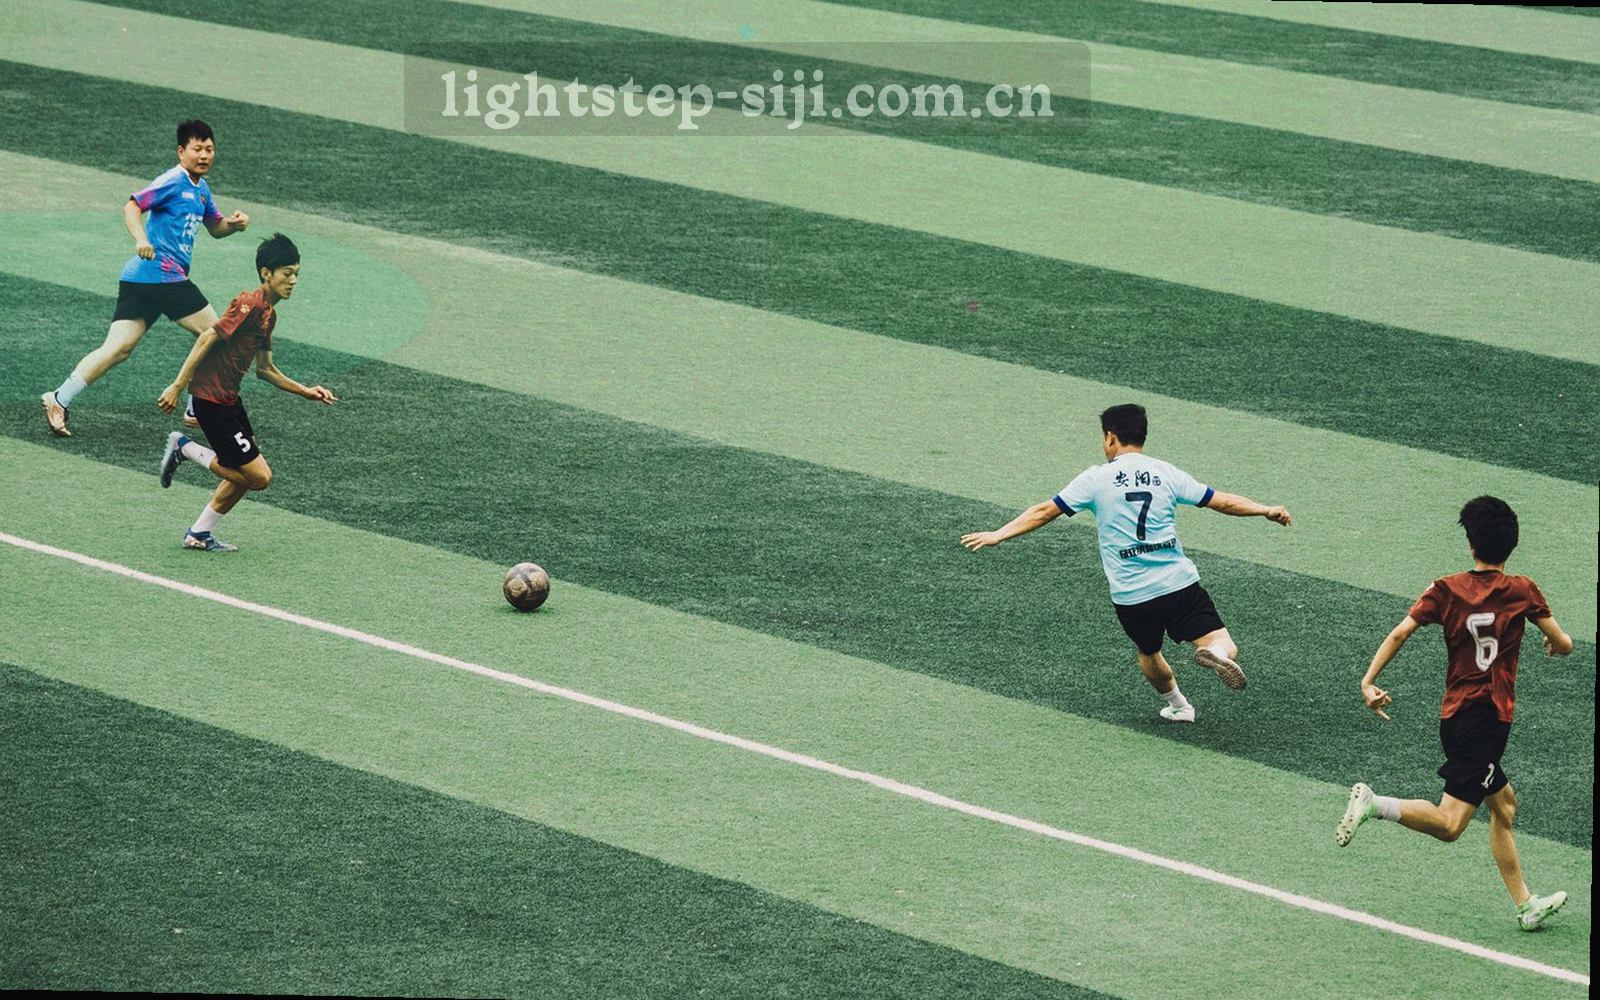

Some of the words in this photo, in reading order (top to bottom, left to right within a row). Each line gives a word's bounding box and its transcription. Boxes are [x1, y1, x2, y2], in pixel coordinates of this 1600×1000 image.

[234, 431, 251, 453] 5
[1125, 492, 1152, 541] 7
[1466, 612, 1498, 672] 6
